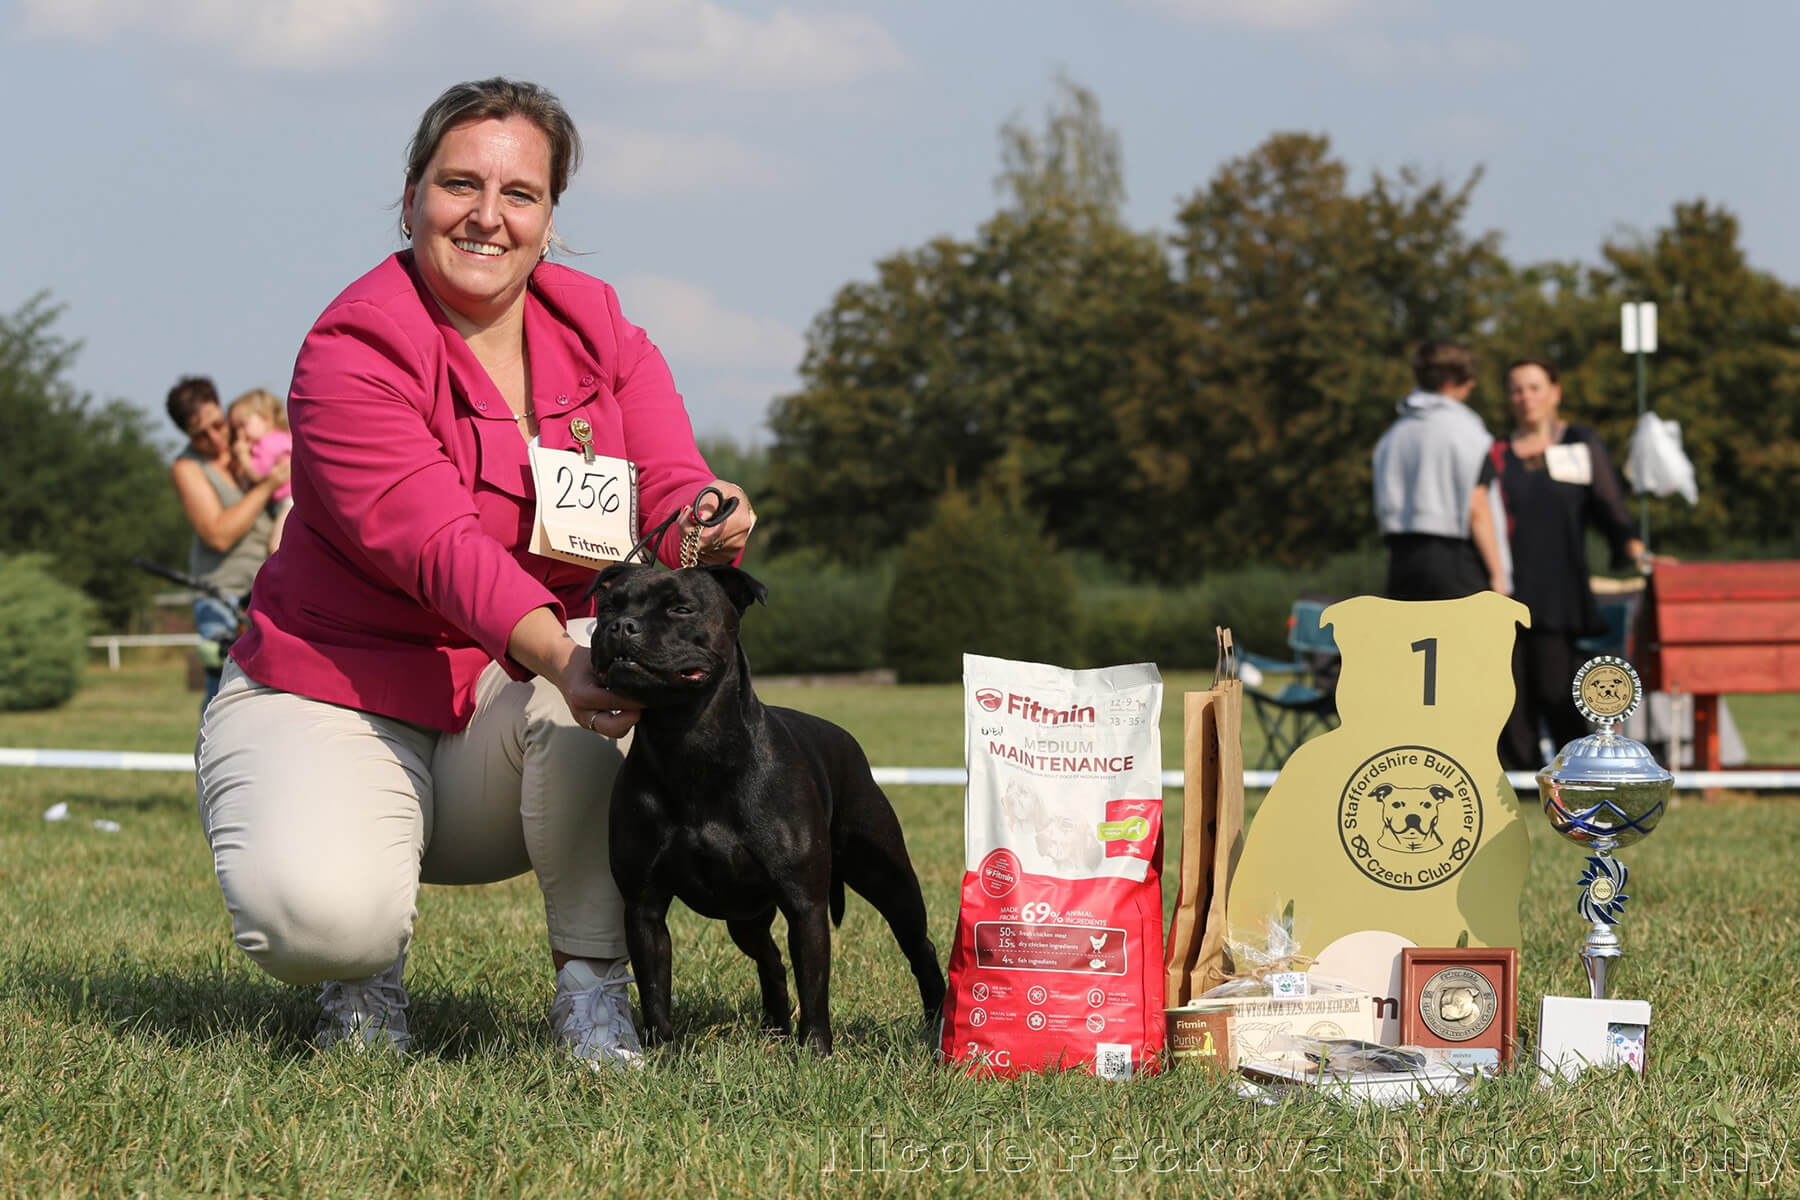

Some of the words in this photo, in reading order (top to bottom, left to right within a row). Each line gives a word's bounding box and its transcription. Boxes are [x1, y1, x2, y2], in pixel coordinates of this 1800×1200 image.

[555, 466, 620, 515] 256
[568, 535, 620, 556] Fitmin
[1411, 637, 1437, 706] 1
[1007, 693, 1096, 725] Fitmin
[989, 741, 1134, 772] MAINTENANCE
[1024, 737, 1093, 753] MEDIUM
[1344, 753, 1418, 829] Staffordshire
[1423, 754, 1456, 779] Bull
[1453, 777, 1477, 833] Terrier
[1367, 858, 1413, 884] Czech
[1417, 861, 1452, 883] Club
[1021, 902, 1063, 923] 69%
[1065, 918, 1107, 926] INGREDIENTS
[1176, 1019, 1207, 1030] Fitmin
[1173, 1034, 1201, 1047] Purity
